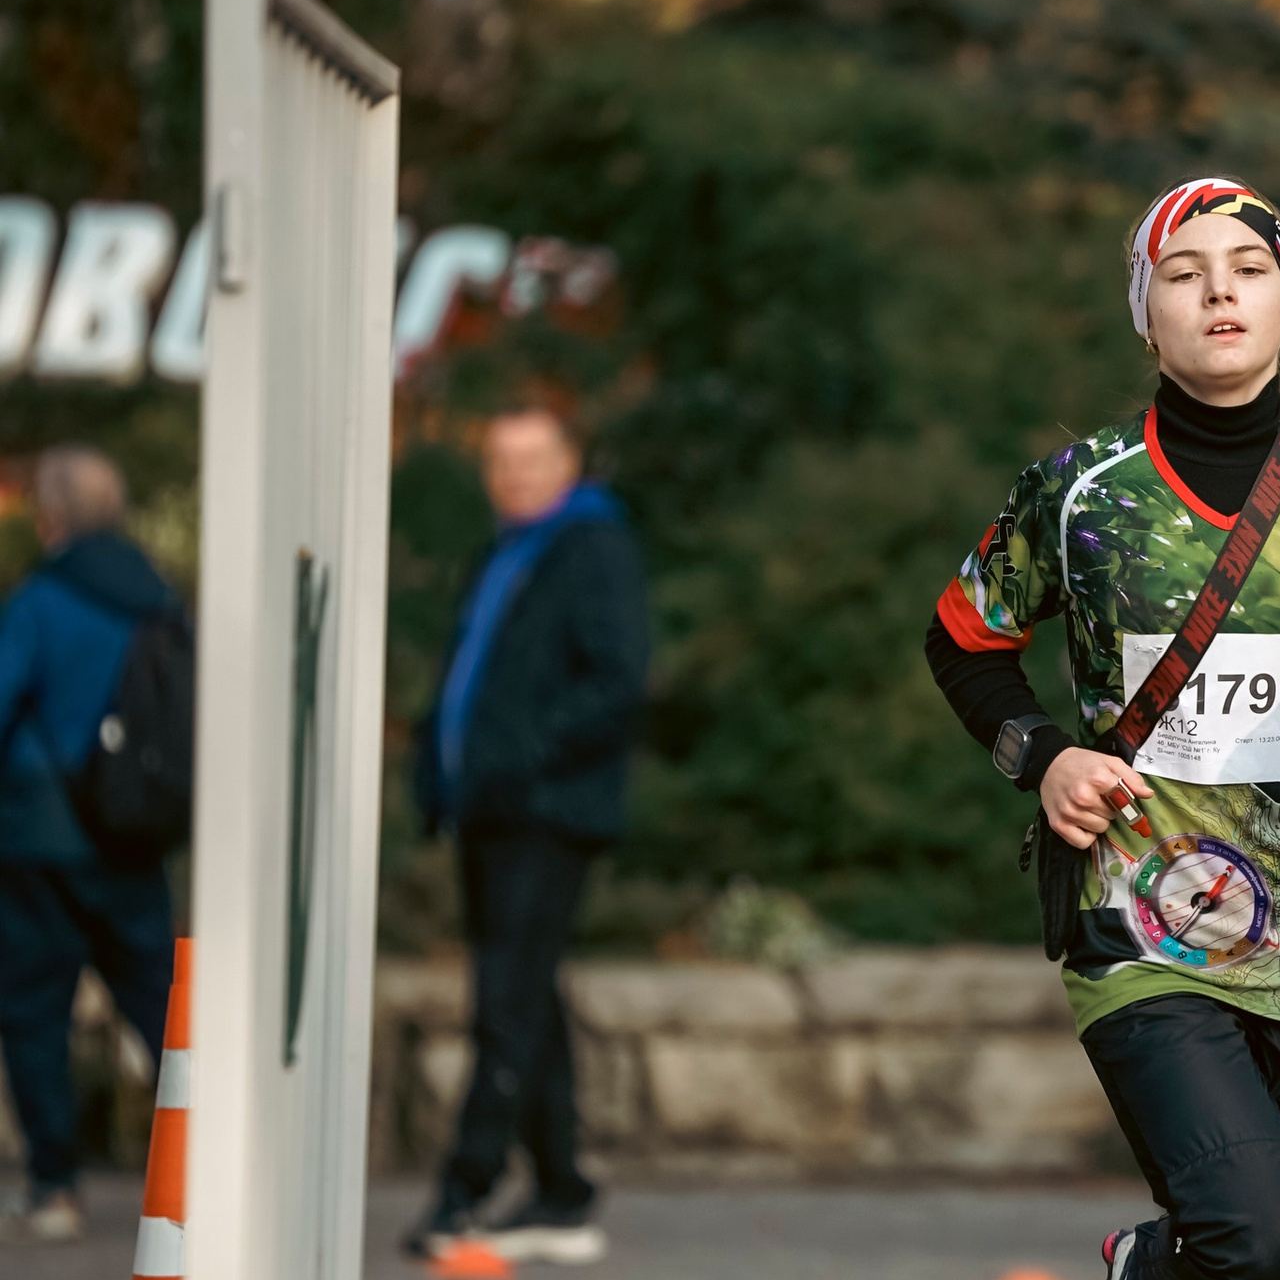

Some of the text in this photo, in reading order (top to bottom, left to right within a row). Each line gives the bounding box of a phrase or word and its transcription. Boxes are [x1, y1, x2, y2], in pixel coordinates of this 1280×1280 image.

[1217, 517, 1262, 588] NIKE
[1182, 583, 1229, 653] NIKE
[1144, 649, 1190, 713] NIKE
[1166, 672, 1277, 716] 179
[1234, 737, 1253, 745] Старт
